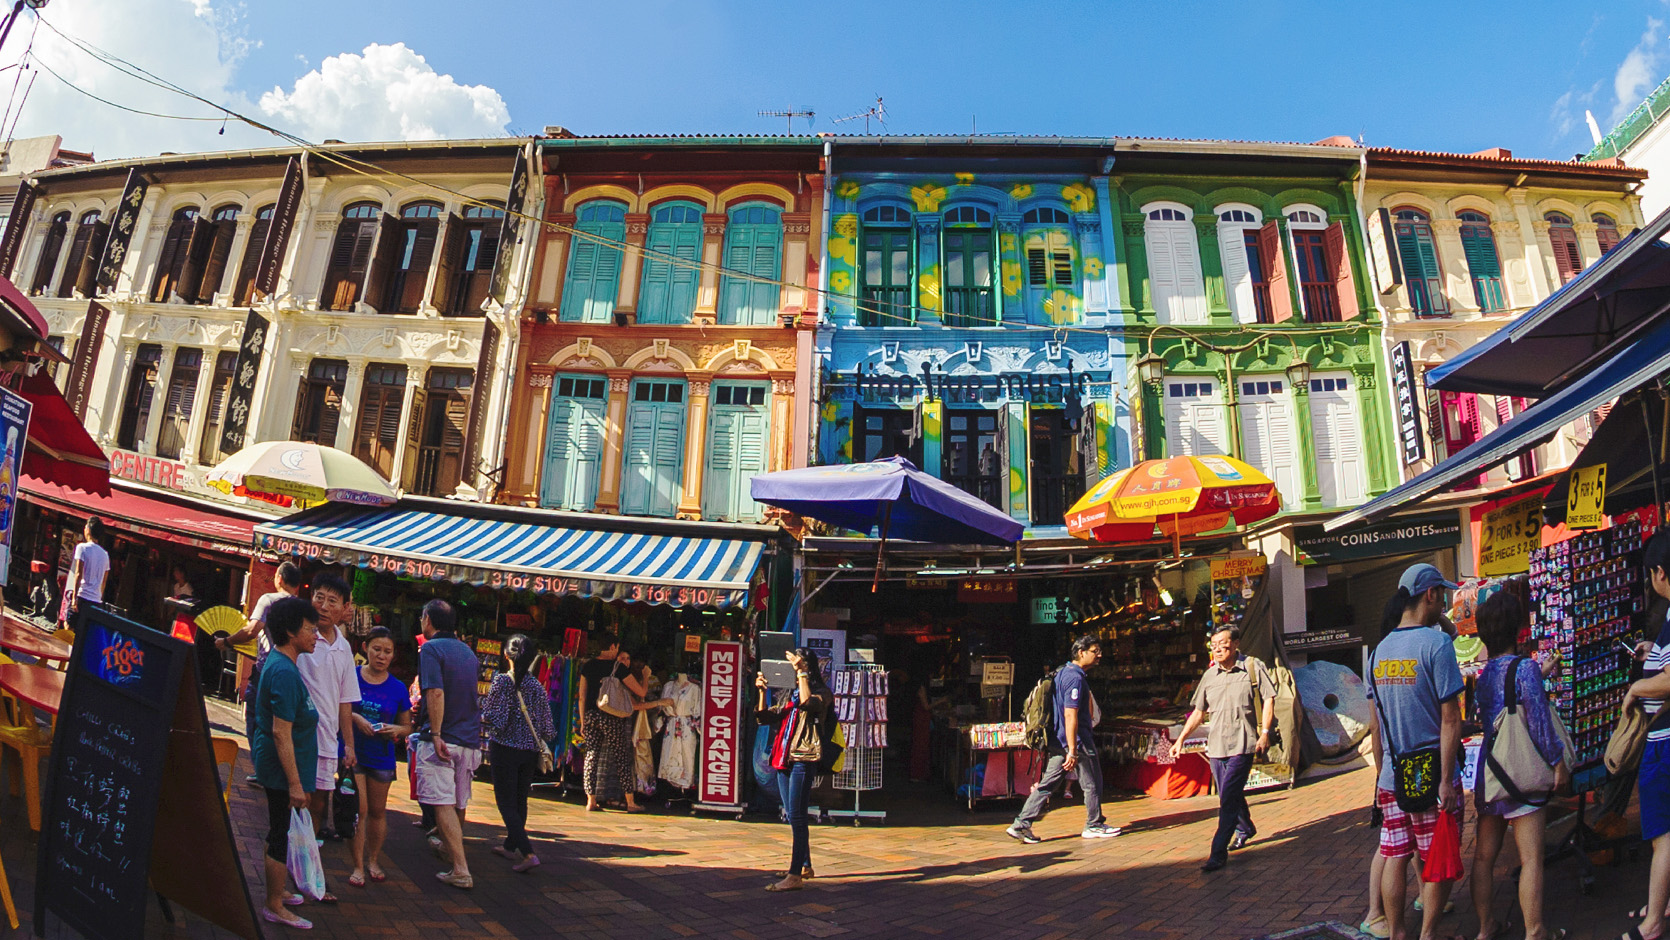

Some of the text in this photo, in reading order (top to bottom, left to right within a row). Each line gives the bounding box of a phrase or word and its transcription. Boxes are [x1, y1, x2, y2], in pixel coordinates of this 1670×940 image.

[16, 188, 32, 225] Chinatown
[6, 225, 20, 256] Heritage
[265, 169, 301, 292] Chinatown Heritage Centre
[87, 308, 104, 354] Chinatown
[78, 355, 92, 391] Heritage
[854, 362, 914, 397] tino
[921, 361, 983, 403] live
[470, 327, 497, 481] Chinatown Heritage Centre
[110, 450, 185, 491] CENTRE
[1121, 495, 1190, 510] www.gjh.com.sg
[1570, 471, 1580, 511] 3
[1580, 482, 1591, 497] FOR
[1595, 467, 1605, 509] 5
[1482, 508, 1540, 551] 2 FOR $ 5
[1567, 515, 1578, 524] ONE
[1578, 514, 1593, 523] PIECE
[267, 535, 331, 557] 3 for $10/=
[1299, 524, 1459, 547] SINGAPORE COINS AND NOTES MUSEUM
[369, 555, 446, 577] 3 for $10/=
[1224, 559, 1254, 569] MERRY
[1480, 551, 1494, 566] ONE
[1494, 546, 1516, 562] PIECE
[1522, 539, 1539, 553] 2.90
[492, 572, 578, 593] 3 for $10/=
[1212, 565, 1266, 578] CHRISTMAS
[632, 586, 726, 605] 3 for $10/=
[1036, 600, 1054, 611] tino
[1307, 635, 1334, 643] LARGEST
[102, 641, 145, 675] Tiger
[707, 651, 734, 796] MONEY CHANGER
